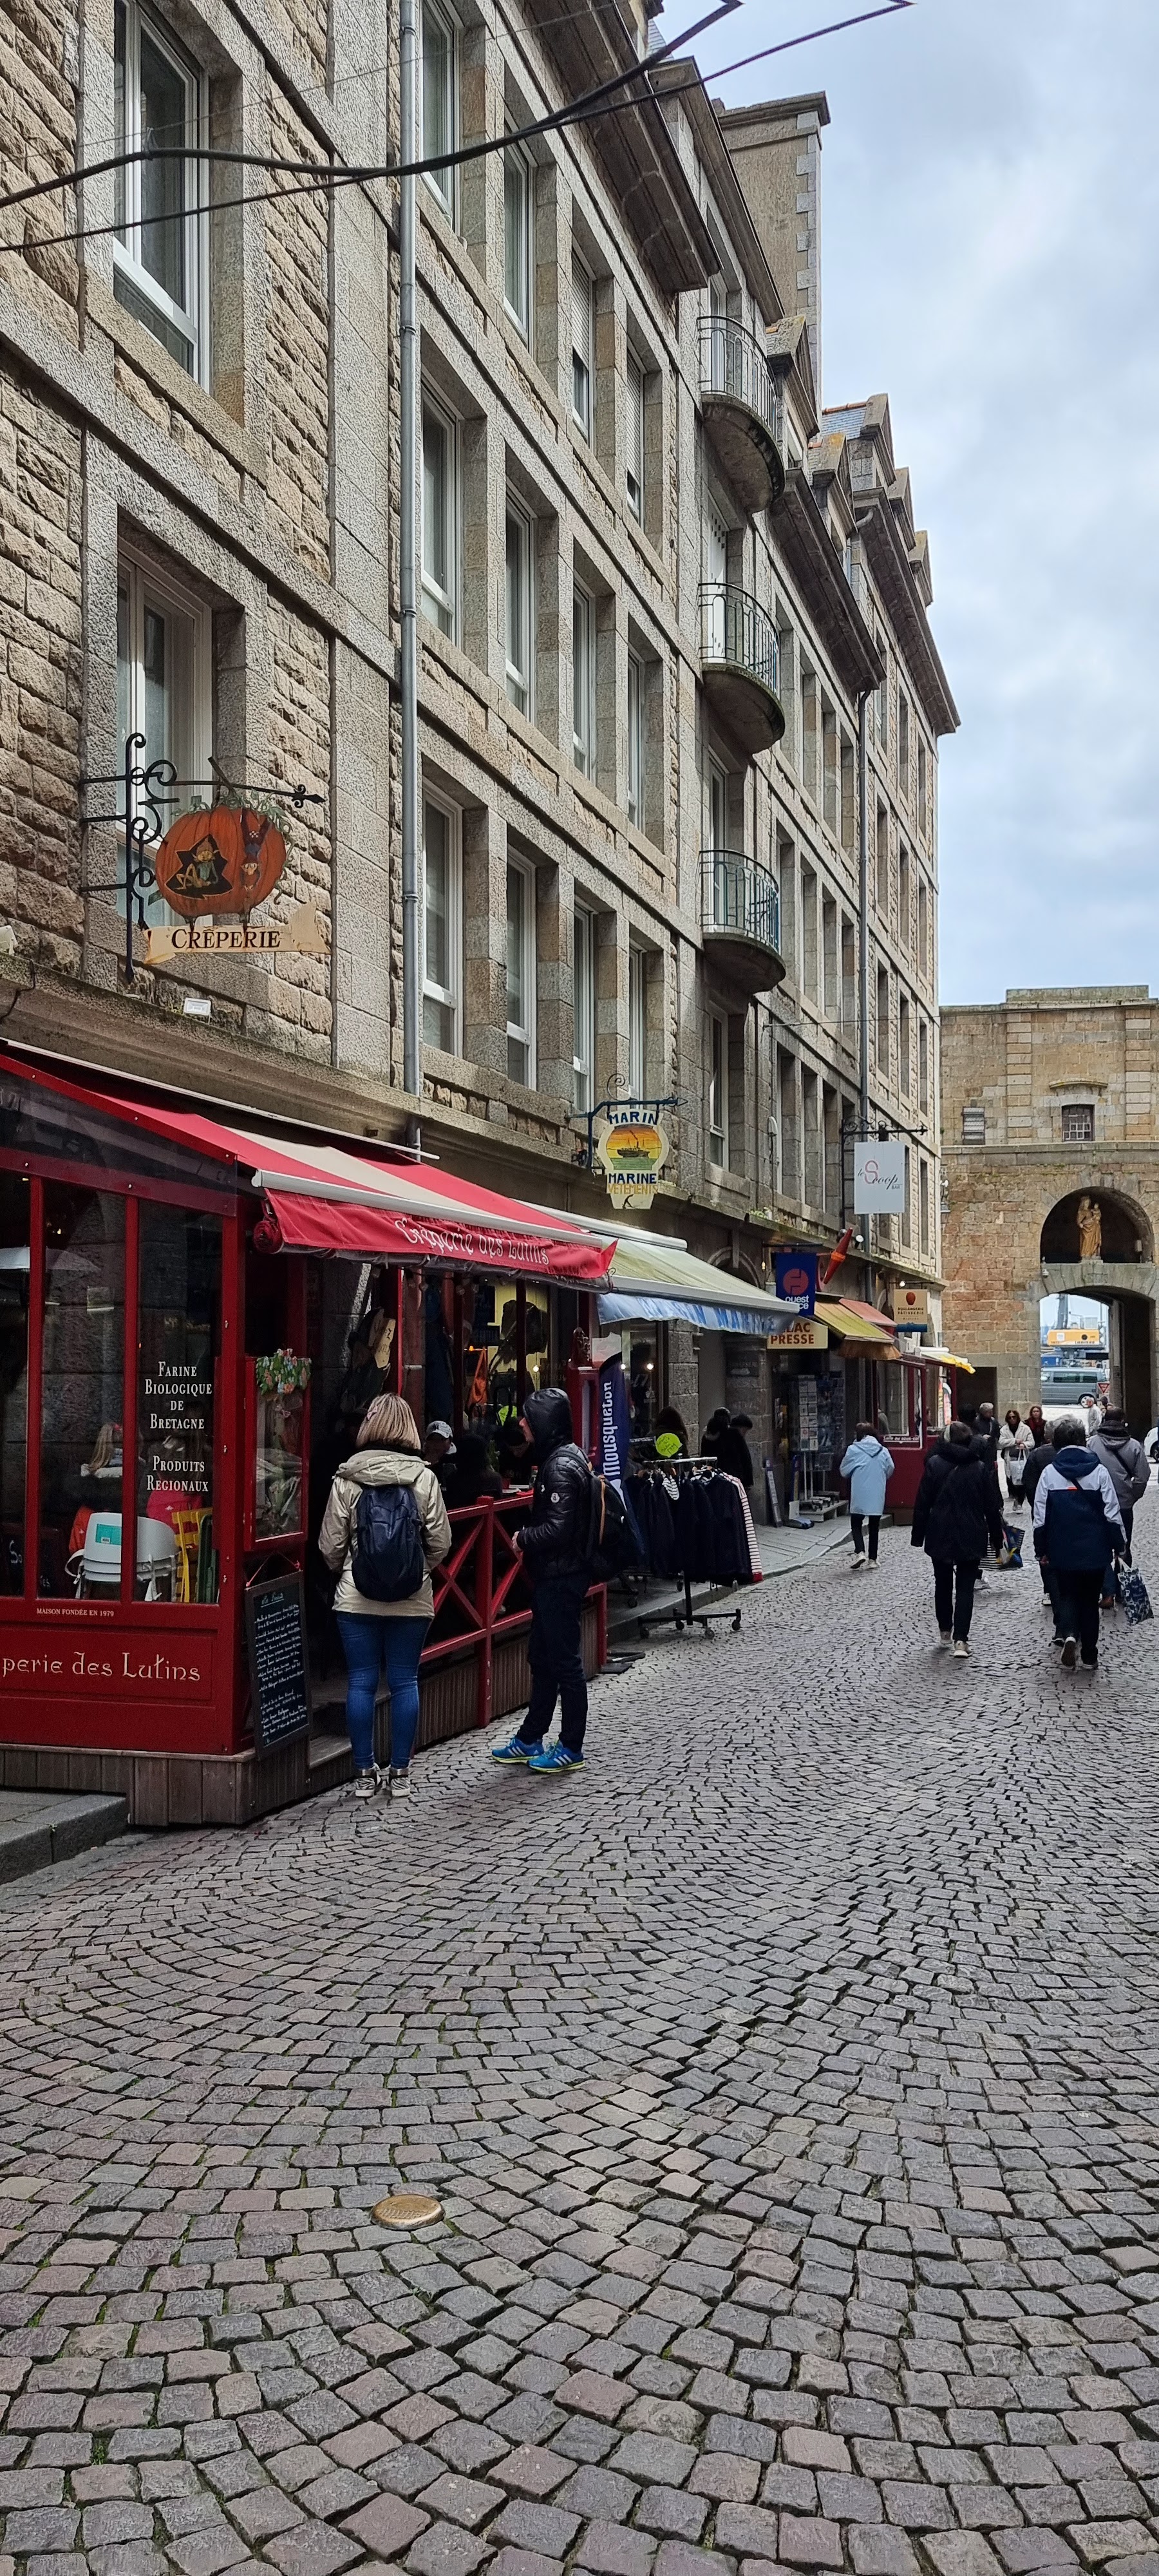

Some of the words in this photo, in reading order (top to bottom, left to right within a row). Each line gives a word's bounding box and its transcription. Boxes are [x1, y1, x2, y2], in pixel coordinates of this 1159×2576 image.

[171, 929, 281, 949] CRÊPERIE
[609, 1112, 659, 1125] MARIN
[608, 1173, 657, 1184] MARINE
[478, 1234, 504, 1258] des
[771, 1334, 814, 1344] PRESSE
[158, 1361, 197, 1377] FARINE
[144, 1378, 212, 1397] BIOLOGIQUE
[149, 1413, 205, 1429] BRETAGNE
[602, 1381, 621, 1477] Mousqueton
[153, 1455, 205, 1472] PRODUITS
[147, 1475, 209, 1492] REGIONAUX
[72, 1651, 113, 1676] des
[122, 1652, 200, 1681] Lutins
